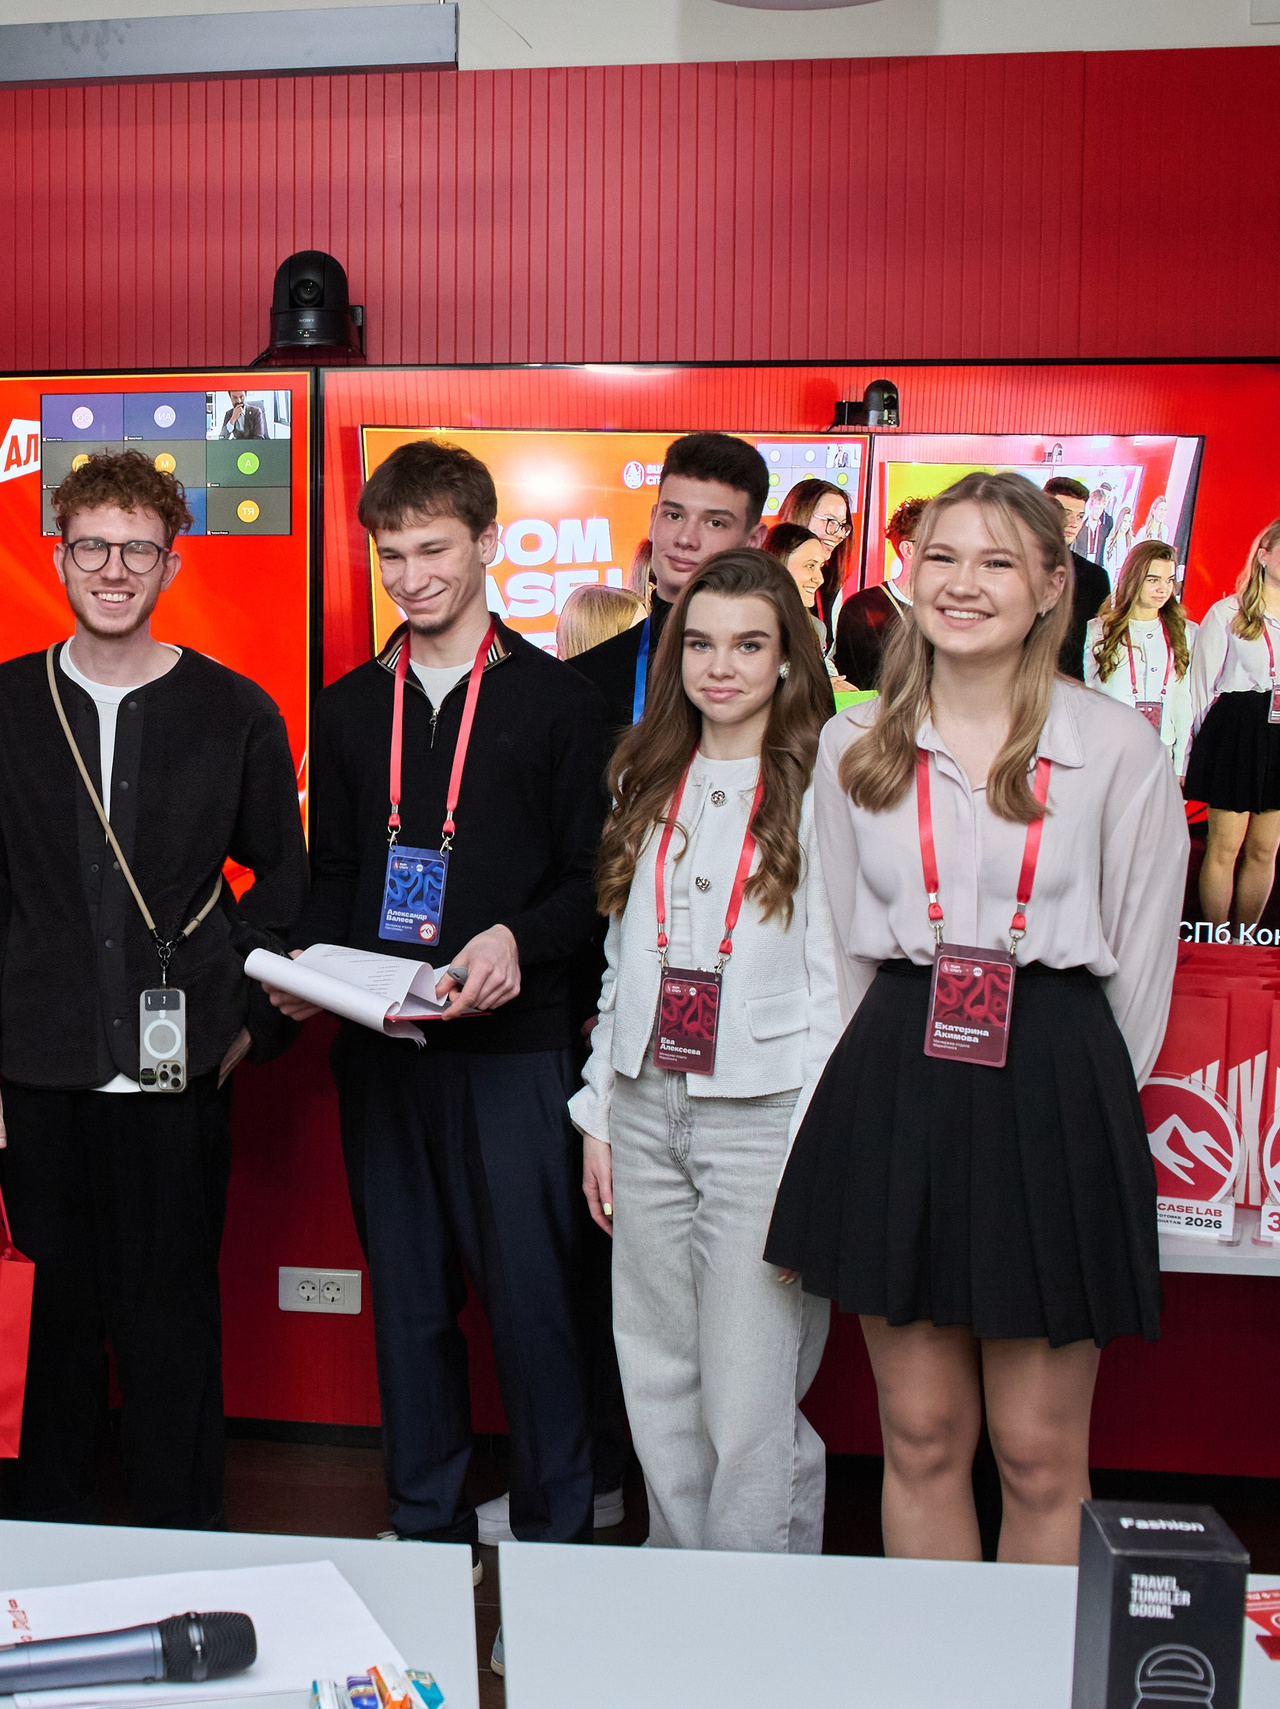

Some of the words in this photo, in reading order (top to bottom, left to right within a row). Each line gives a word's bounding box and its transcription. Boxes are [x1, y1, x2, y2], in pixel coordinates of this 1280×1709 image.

[486, 518, 613, 568] OM
[387, 909, 427, 921] Александр
[1178, 921, 1231, 944] СПб
[934, 1021, 990, 1037] Екатерина
[934, 1029, 979, 1043] Акимова
[660, 1037, 675, 1045] Ева
[660, 1043, 701, 1056] Алексеева
[1157, 1203, 1193, 1215] CASE
[1196, 1207, 1223, 1217] LAB
[1185, 1217, 1222, 1229] 2026
[1120, 1517, 1204, 1532] Fashion
[1131, 1573, 1179, 1592] TRAVEL
[1130, 1588, 1191, 1607] TUMBLER
